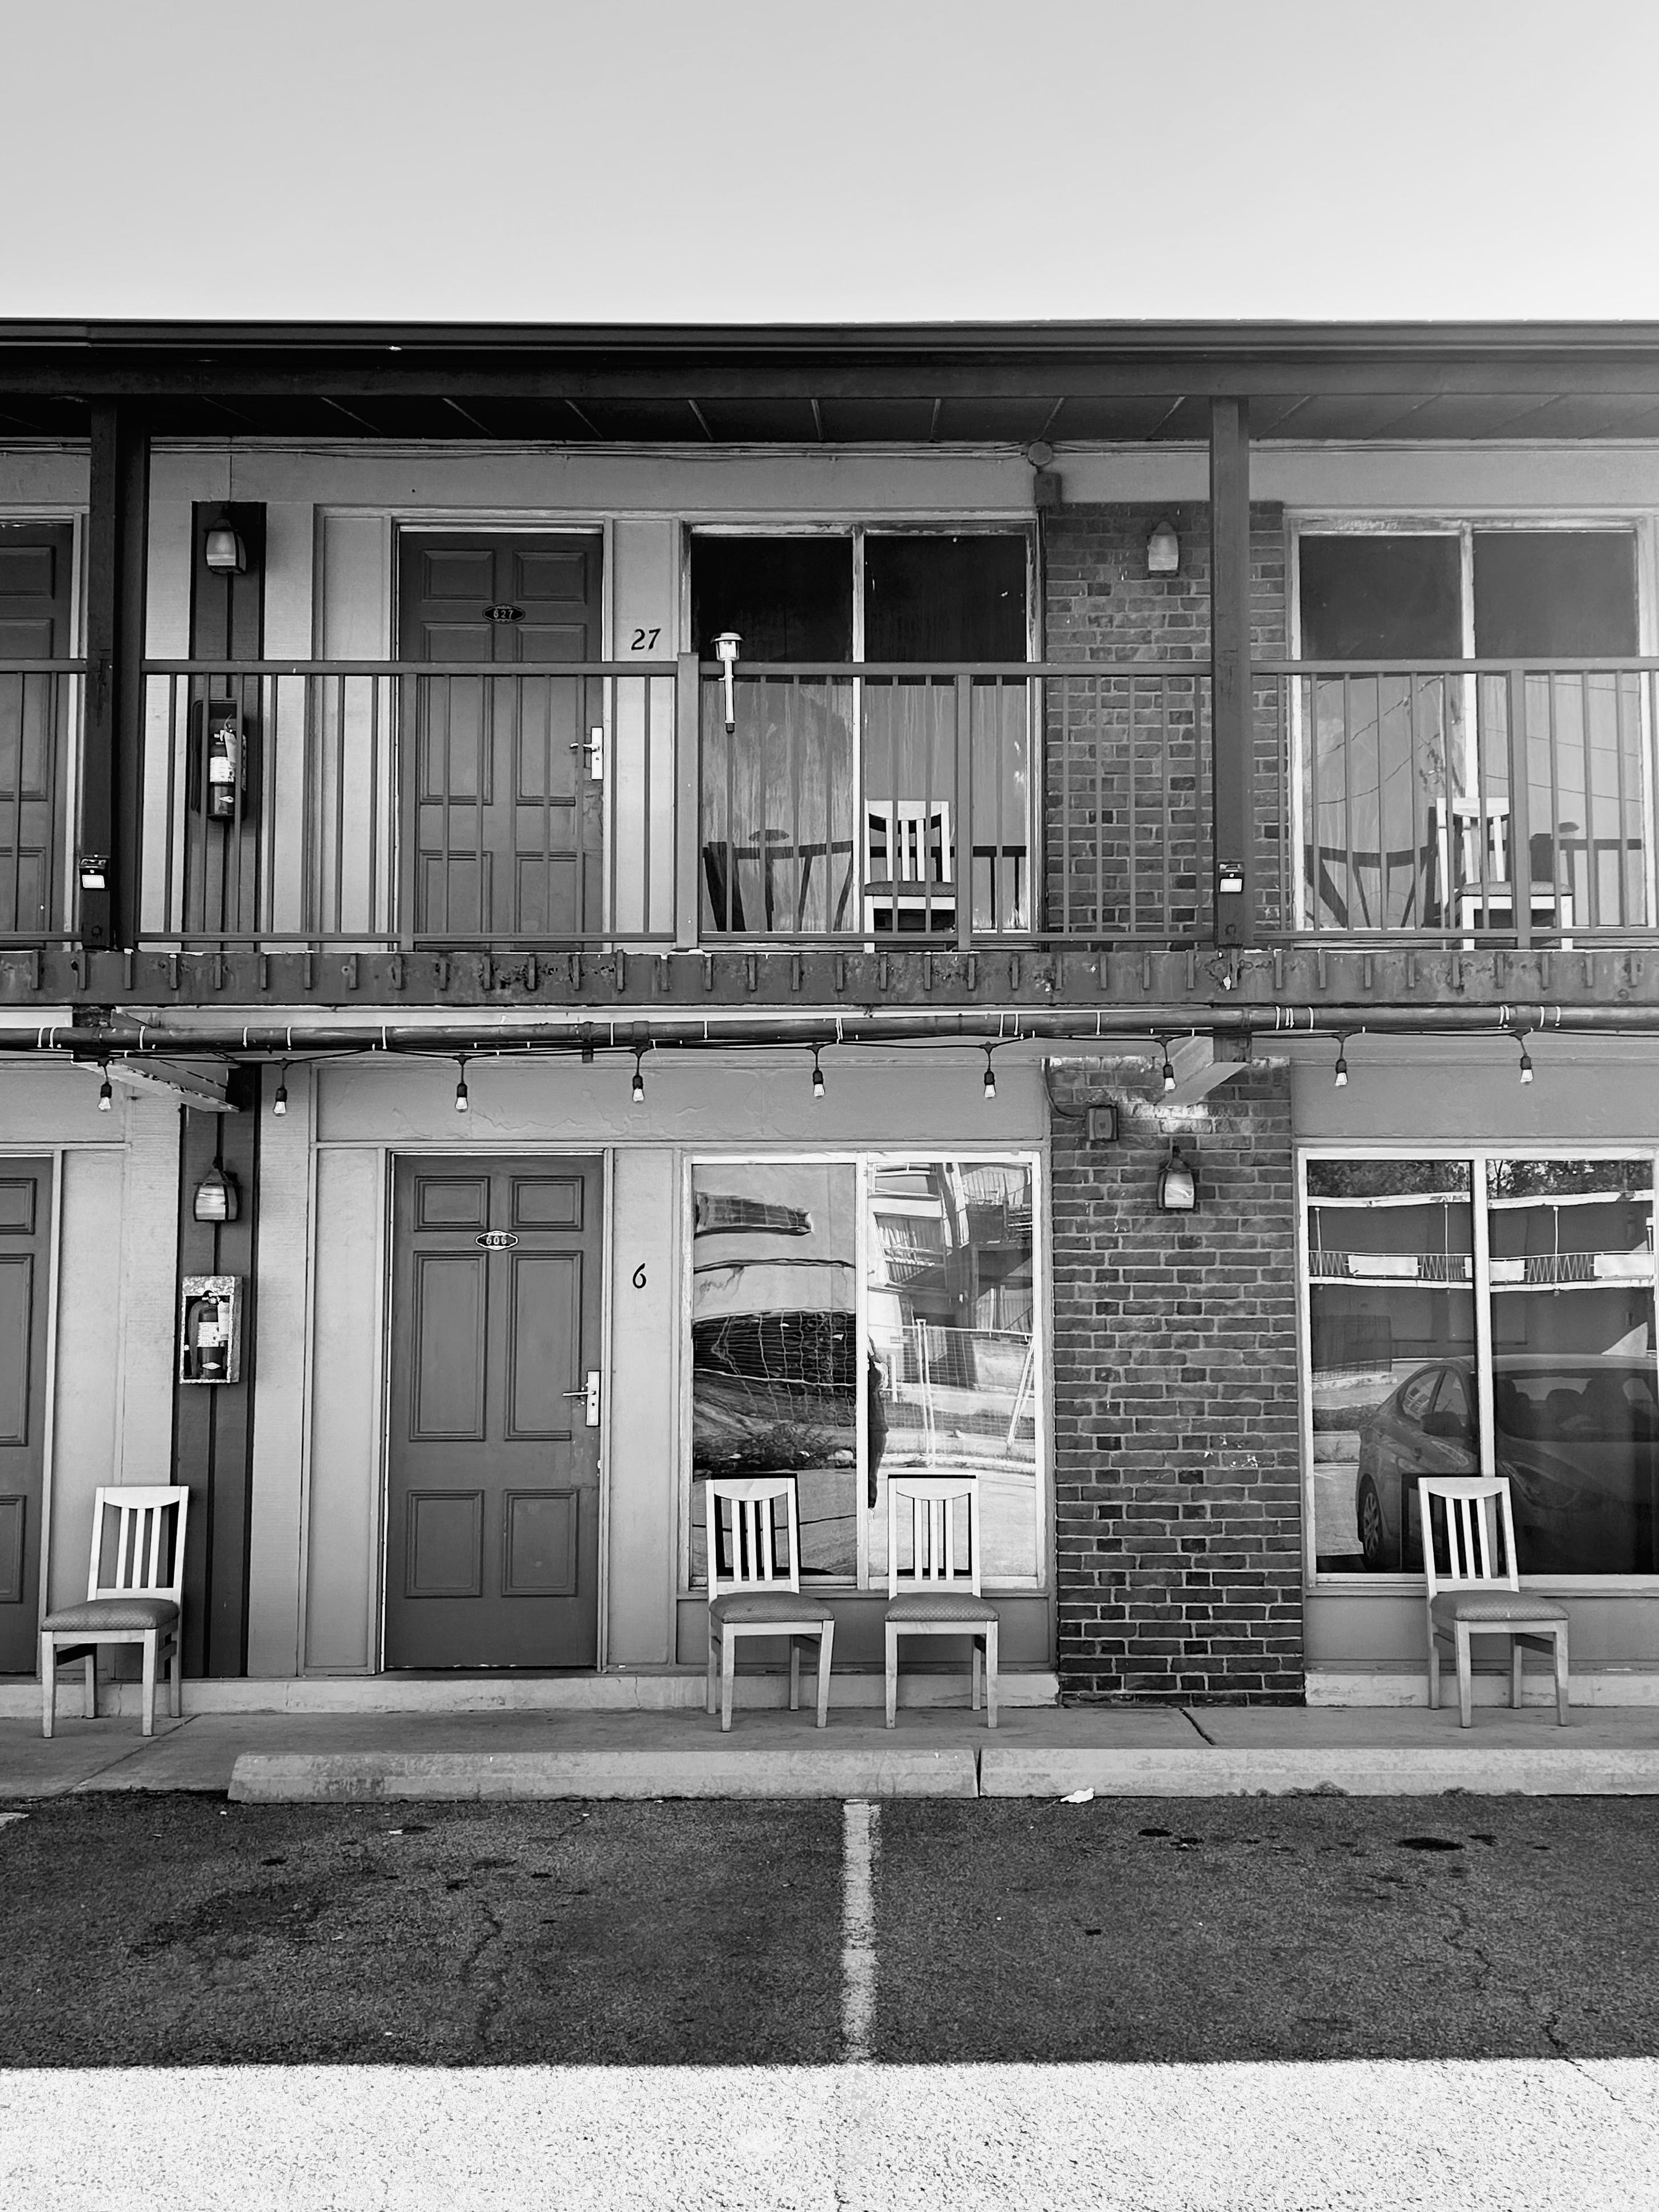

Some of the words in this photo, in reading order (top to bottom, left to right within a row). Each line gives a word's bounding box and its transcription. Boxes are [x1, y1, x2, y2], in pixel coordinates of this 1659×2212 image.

[493, 609, 514, 619] 627
[631, 628, 661, 651] 27
[486, 1236, 507, 1245] 606
[633, 1262, 647, 1289] 6
